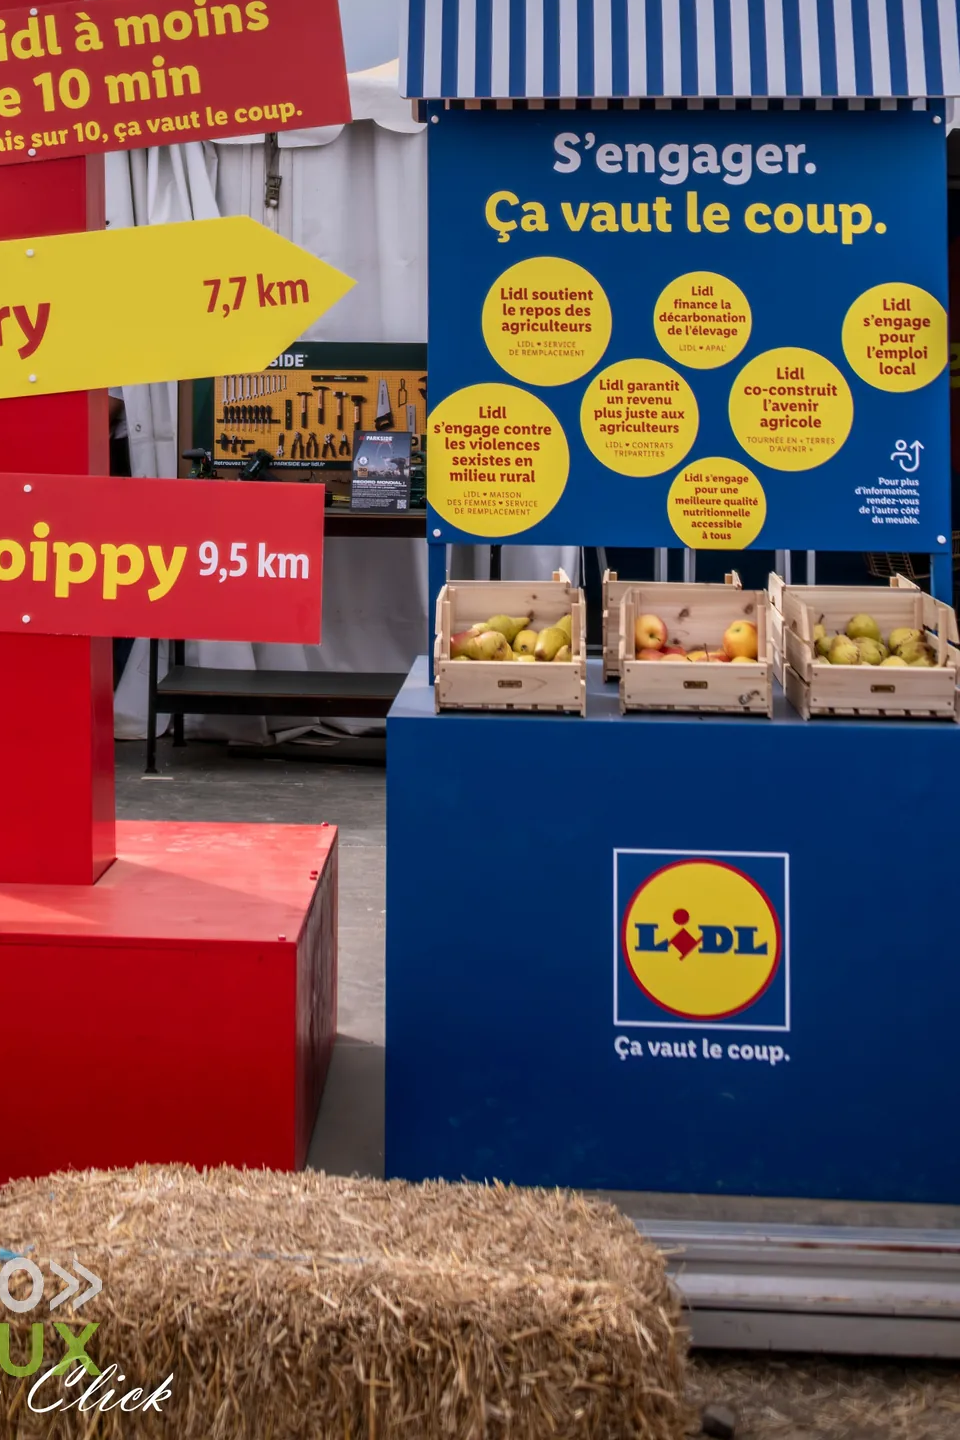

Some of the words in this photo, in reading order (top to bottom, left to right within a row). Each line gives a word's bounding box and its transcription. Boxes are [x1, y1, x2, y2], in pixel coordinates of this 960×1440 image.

[74, 12, 104, 52] à
[33, 68, 90, 112] 10
[104, 55, 201, 104] min
[31, 129, 68, 148] sur
[73, 121, 109, 143] 10,
[113, 121, 142, 143] ça
[146, 111, 200, 133] vaut
[206, 106, 228, 126] le
[234, 102, 303, 123] coup.
[553, 132, 817, 185] S'engager.
[485, 190, 549, 243] Ça
[561, 196, 672, 233] vaut
[687, 191, 730, 233] le
[744, 203, 887, 245] coup.
[203, 276, 247, 318] 7,7
[256, 273, 309, 307] km
[501, 287, 528, 300] Lidl
[532, 289, 593, 301] soutient
[692, 285, 713, 296] Lidl
[503, 303, 516, 316] le
[519, 306, 561, 318] repos
[565, 304, 591, 316] des
[673, 298, 718, 309] finance
[721, 299, 731, 310] la
[883, 298, 911, 311] Lidl
[659, 312, 746, 323] décarbonation
[863, 314, 931, 330] s'engage
[502, 319, 592, 335] agriculteurs
[667, 325, 682, 335] de
[685, 325, 738, 338] l'élevage
[879, 333, 915, 345] pour
[867, 346, 928, 361] l'emploi
[777, 366, 805, 380] Lidl
[879, 362, 916, 375] local
[599, 379, 624, 391] Lidl
[627, 379, 680, 393] garantit
[744, 383, 837, 396] co-construit
[607, 396, 623, 404] un
[627, 396, 672, 405] revenu
[763, 398, 819, 412] l'avenir
[479, 406, 507, 419] Lidl
[594, 407, 622, 421] plus
[625, 407, 658, 421] juste
[661, 410, 685, 419] aux
[599, 421, 679, 434] agriculteurs
[760, 414, 822, 431] agricole
[434, 424, 500, 438] s'engage
[504, 424, 552, 436] contre
[445, 437, 466, 450] les
[469, 437, 540, 451] violences
[452, 454, 511, 467] sexistes
[515, 457, 533, 467] en
[449, 469, 496, 482] milieu
[500, 470, 535, 483] rural
[684, 473, 703, 482] Lidl
[705, 474, 749, 485] s'engage
[695, 487, 718, 496] pour
[675, 496, 722, 505] meilleure
[723, 496, 758, 508] qualité
[683, 508, 751, 517] nutritionnelle
[691, 519, 742, 529] accessible
[702, 531, 708, 539] à
[710, 532, 731, 540] tous
[198, 541, 248, 583] 9,5
[258, 542, 309, 579] km
[634, 908, 768, 961] LIDL
[614, 1035, 643, 1060] Ça
[647, 1040, 697, 1058] vaut
[702, 1038, 722, 1059] le
[727, 1044, 790, 1066] coup.
